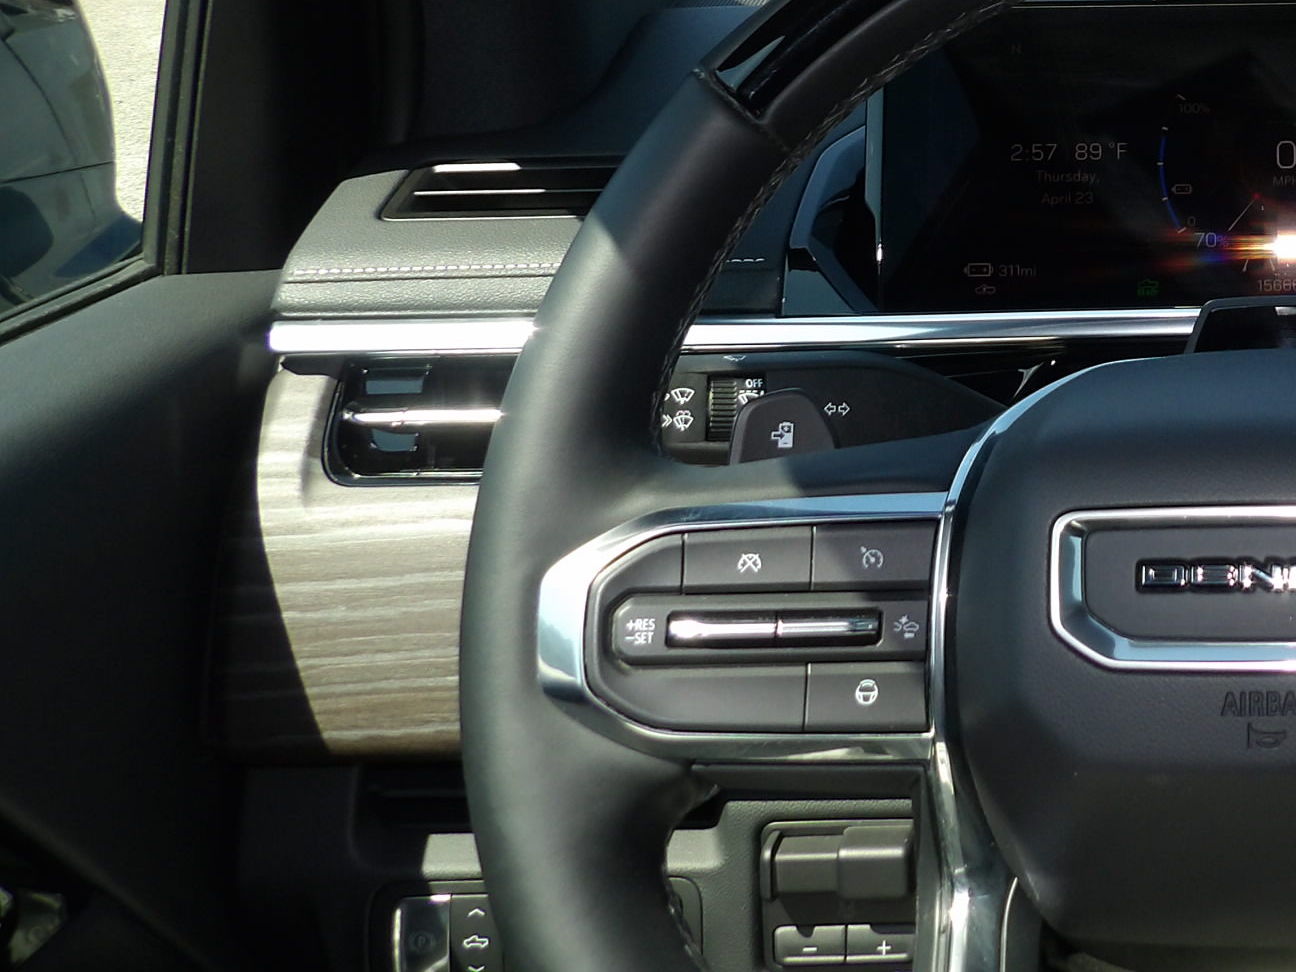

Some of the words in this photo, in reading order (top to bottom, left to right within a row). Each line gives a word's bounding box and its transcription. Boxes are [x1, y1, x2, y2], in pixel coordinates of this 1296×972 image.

[1010, 143, 1058, 162] 2:57
[1040, 191, 1072, 209] April
[1075, 191, 1094, 205] 23
[745, 378, 763, 388] OFF
